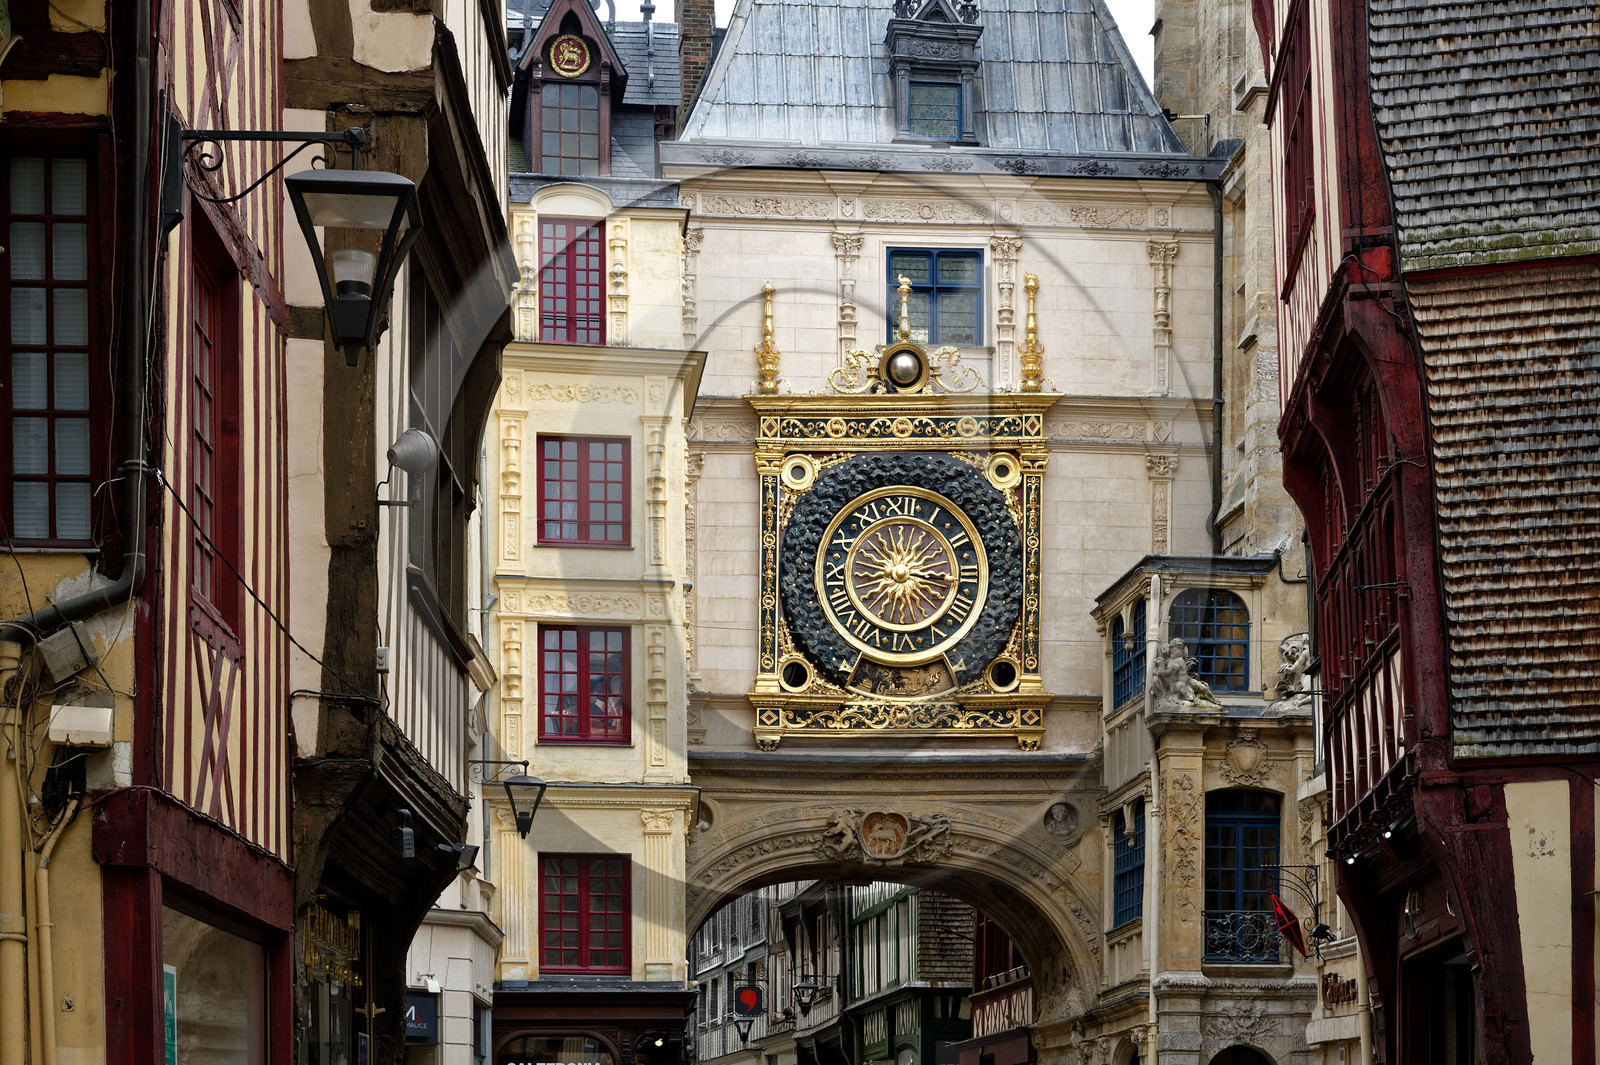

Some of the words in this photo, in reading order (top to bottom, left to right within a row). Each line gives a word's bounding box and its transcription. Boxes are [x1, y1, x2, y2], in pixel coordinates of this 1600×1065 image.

[853, 502, 882, 530] XI
[885, 497, 917, 516] XII
[832, 528, 856, 552] X
[949, 531, 969, 549] II
[960, 564, 978, 584] III
[891, 633, 917, 651] VI
[930, 625, 948, 645] V
